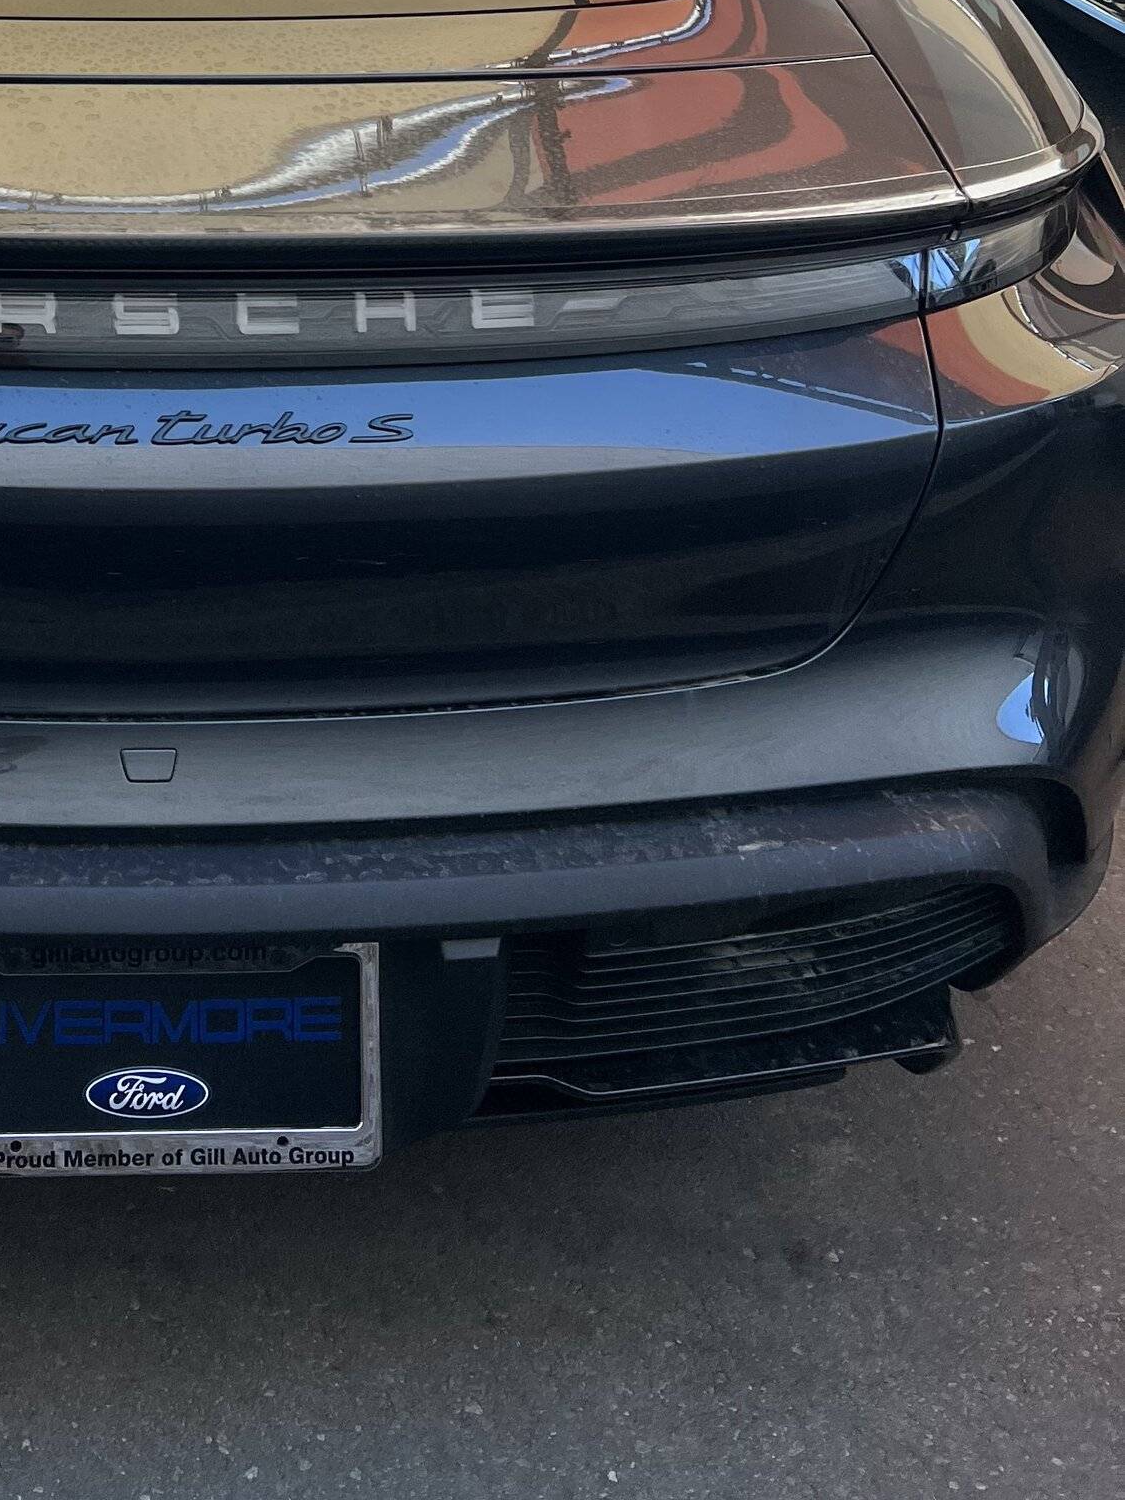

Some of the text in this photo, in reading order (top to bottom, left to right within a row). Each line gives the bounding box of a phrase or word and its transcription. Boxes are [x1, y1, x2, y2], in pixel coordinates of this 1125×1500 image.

[151, 409, 349, 445] turbo
[349, 413, 414, 445] S
[107, 1074, 186, 1111] Ford
[63, 1149, 155, 1168] Member
[161, 1148, 183, 1166] of
[190, 1147, 226, 1166] Gill
[232, 1147, 282, 1165] Auto
[288, 1146, 355, 1167] Group
